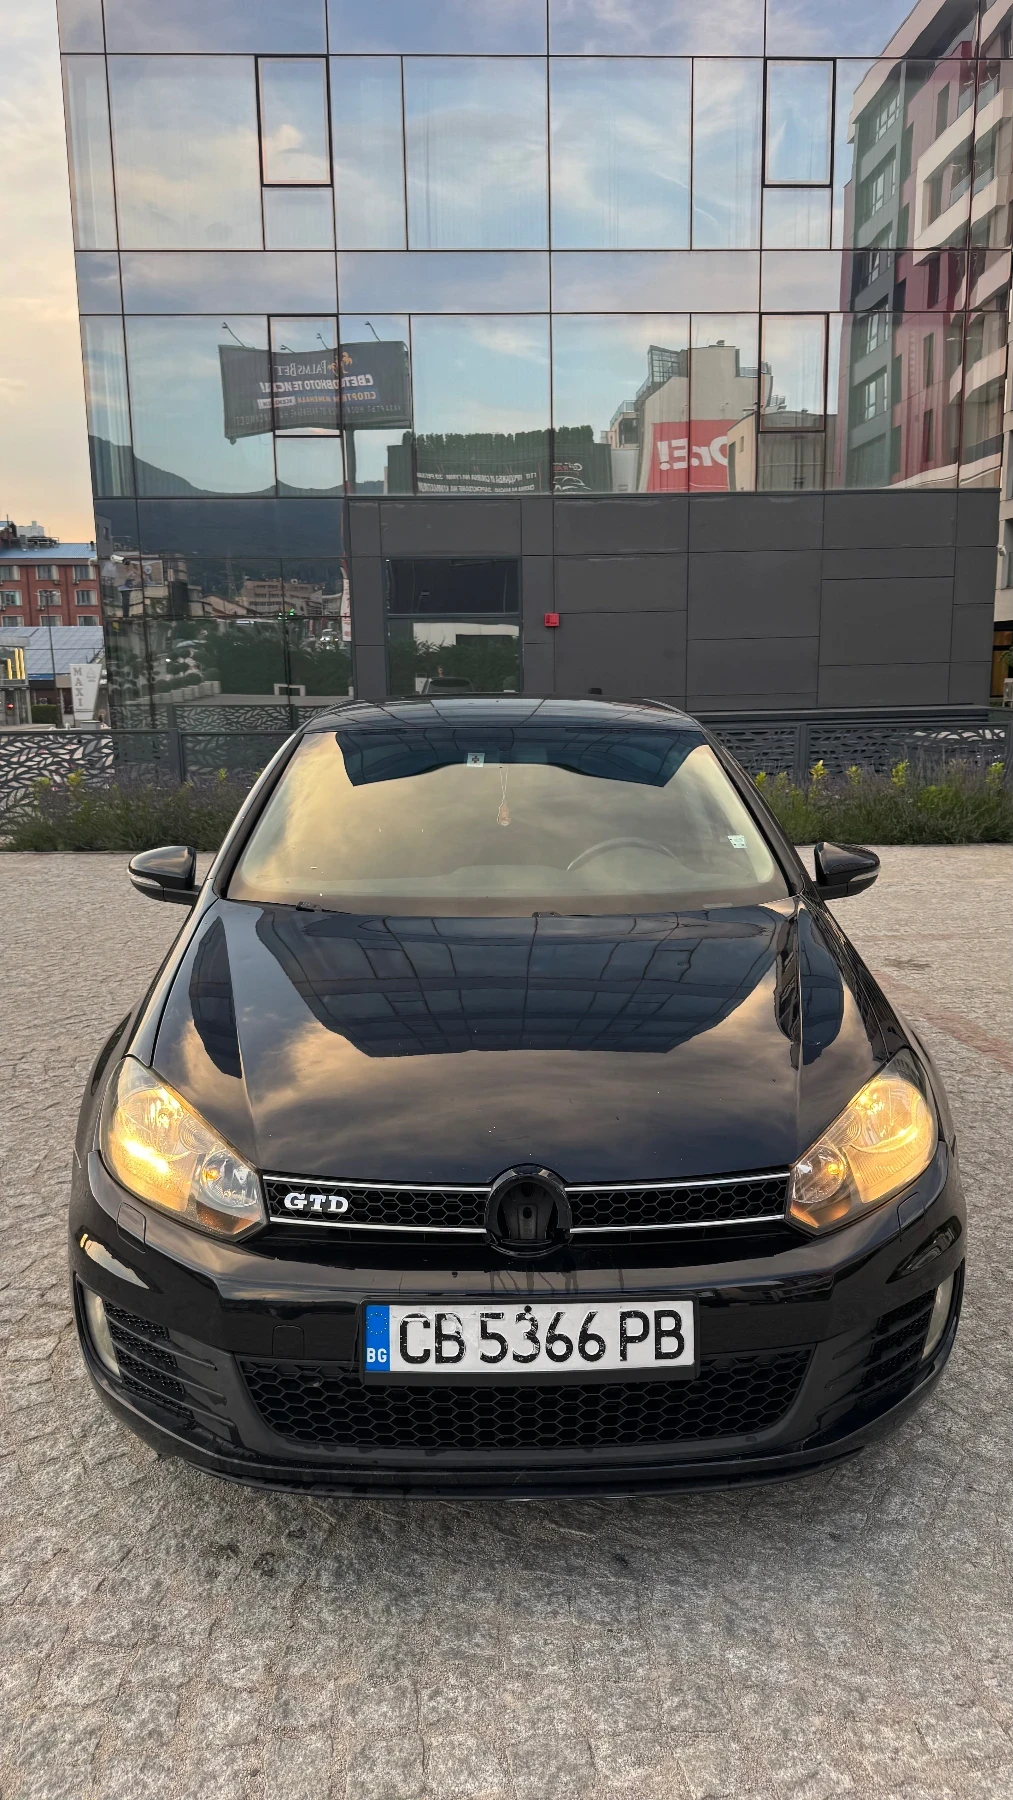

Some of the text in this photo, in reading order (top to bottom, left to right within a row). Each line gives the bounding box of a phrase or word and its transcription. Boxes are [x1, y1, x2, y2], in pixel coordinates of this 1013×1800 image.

[73, 667, 84, 707] MAXI
[284, 1192, 349, 1213] GTD
[400, 1309, 685, 1364] CB 5366 PB
[367, 1347, 387, 1363] BG
